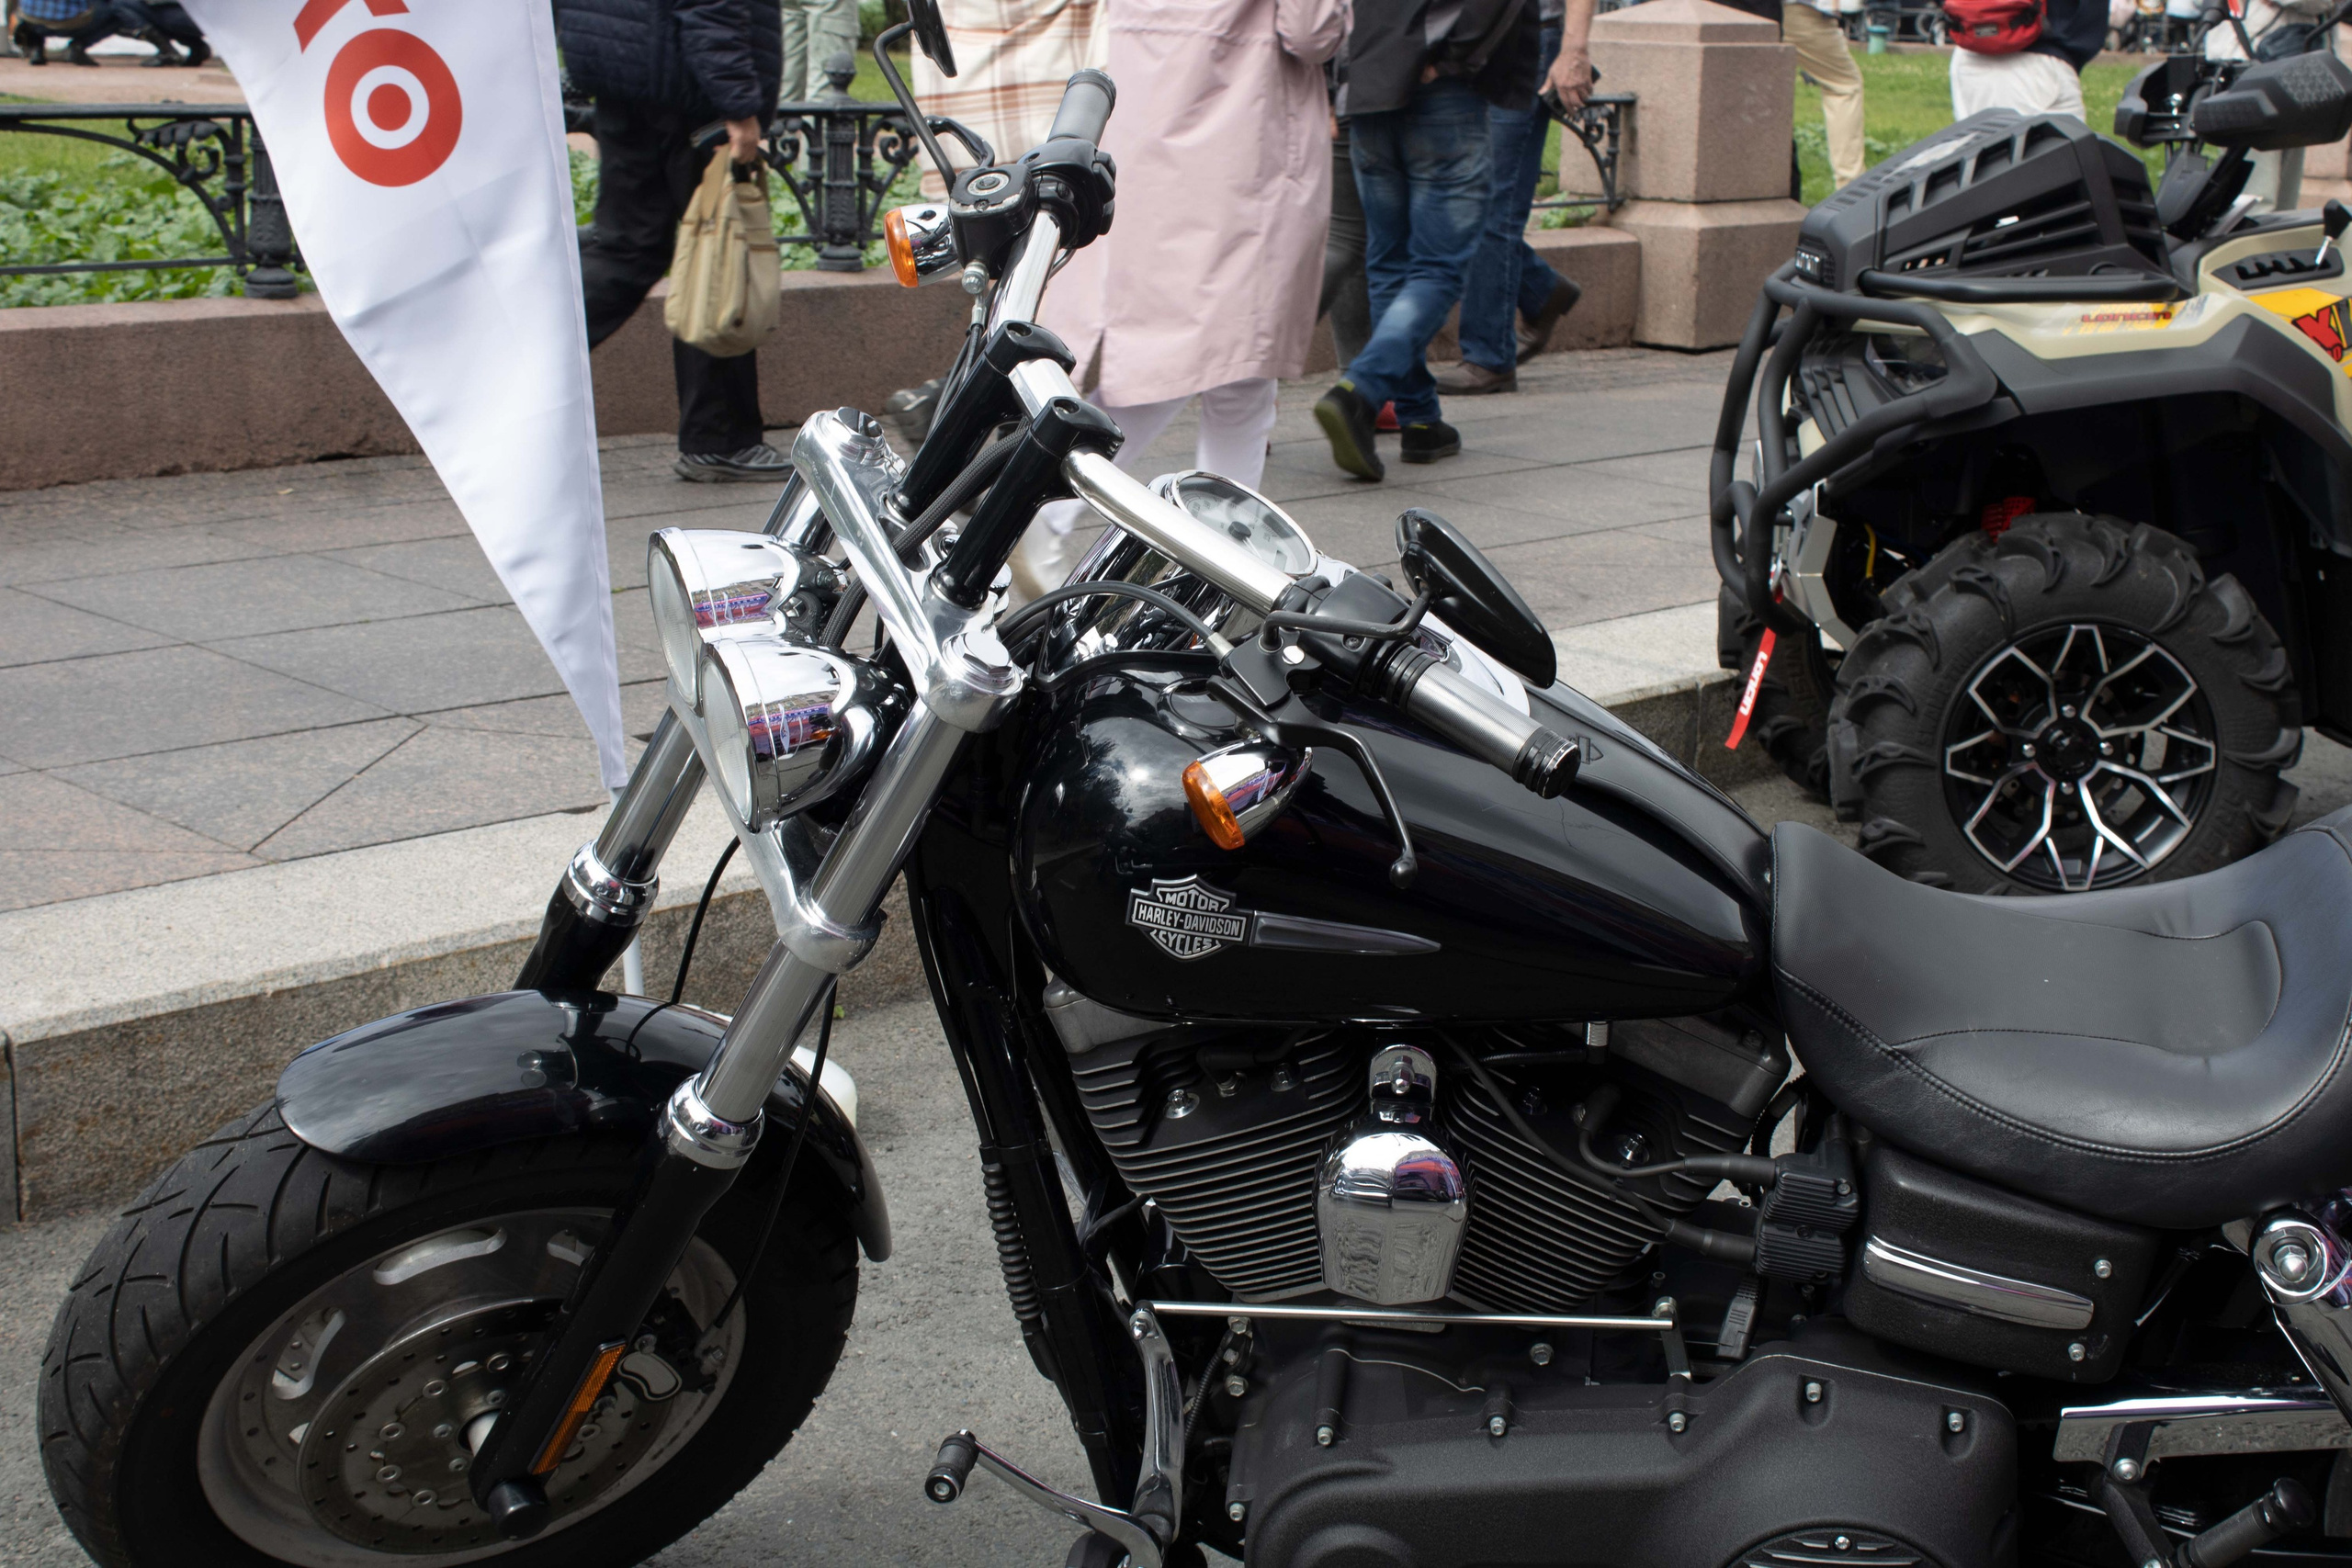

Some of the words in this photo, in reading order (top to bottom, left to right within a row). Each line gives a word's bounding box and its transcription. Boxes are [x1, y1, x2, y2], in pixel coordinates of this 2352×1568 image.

[1164, 888, 1219, 912] MOTOR
[1138, 903, 1241, 937] HARLEY-DAVIDSON
[1159, 930, 1213, 955] CYCLES
